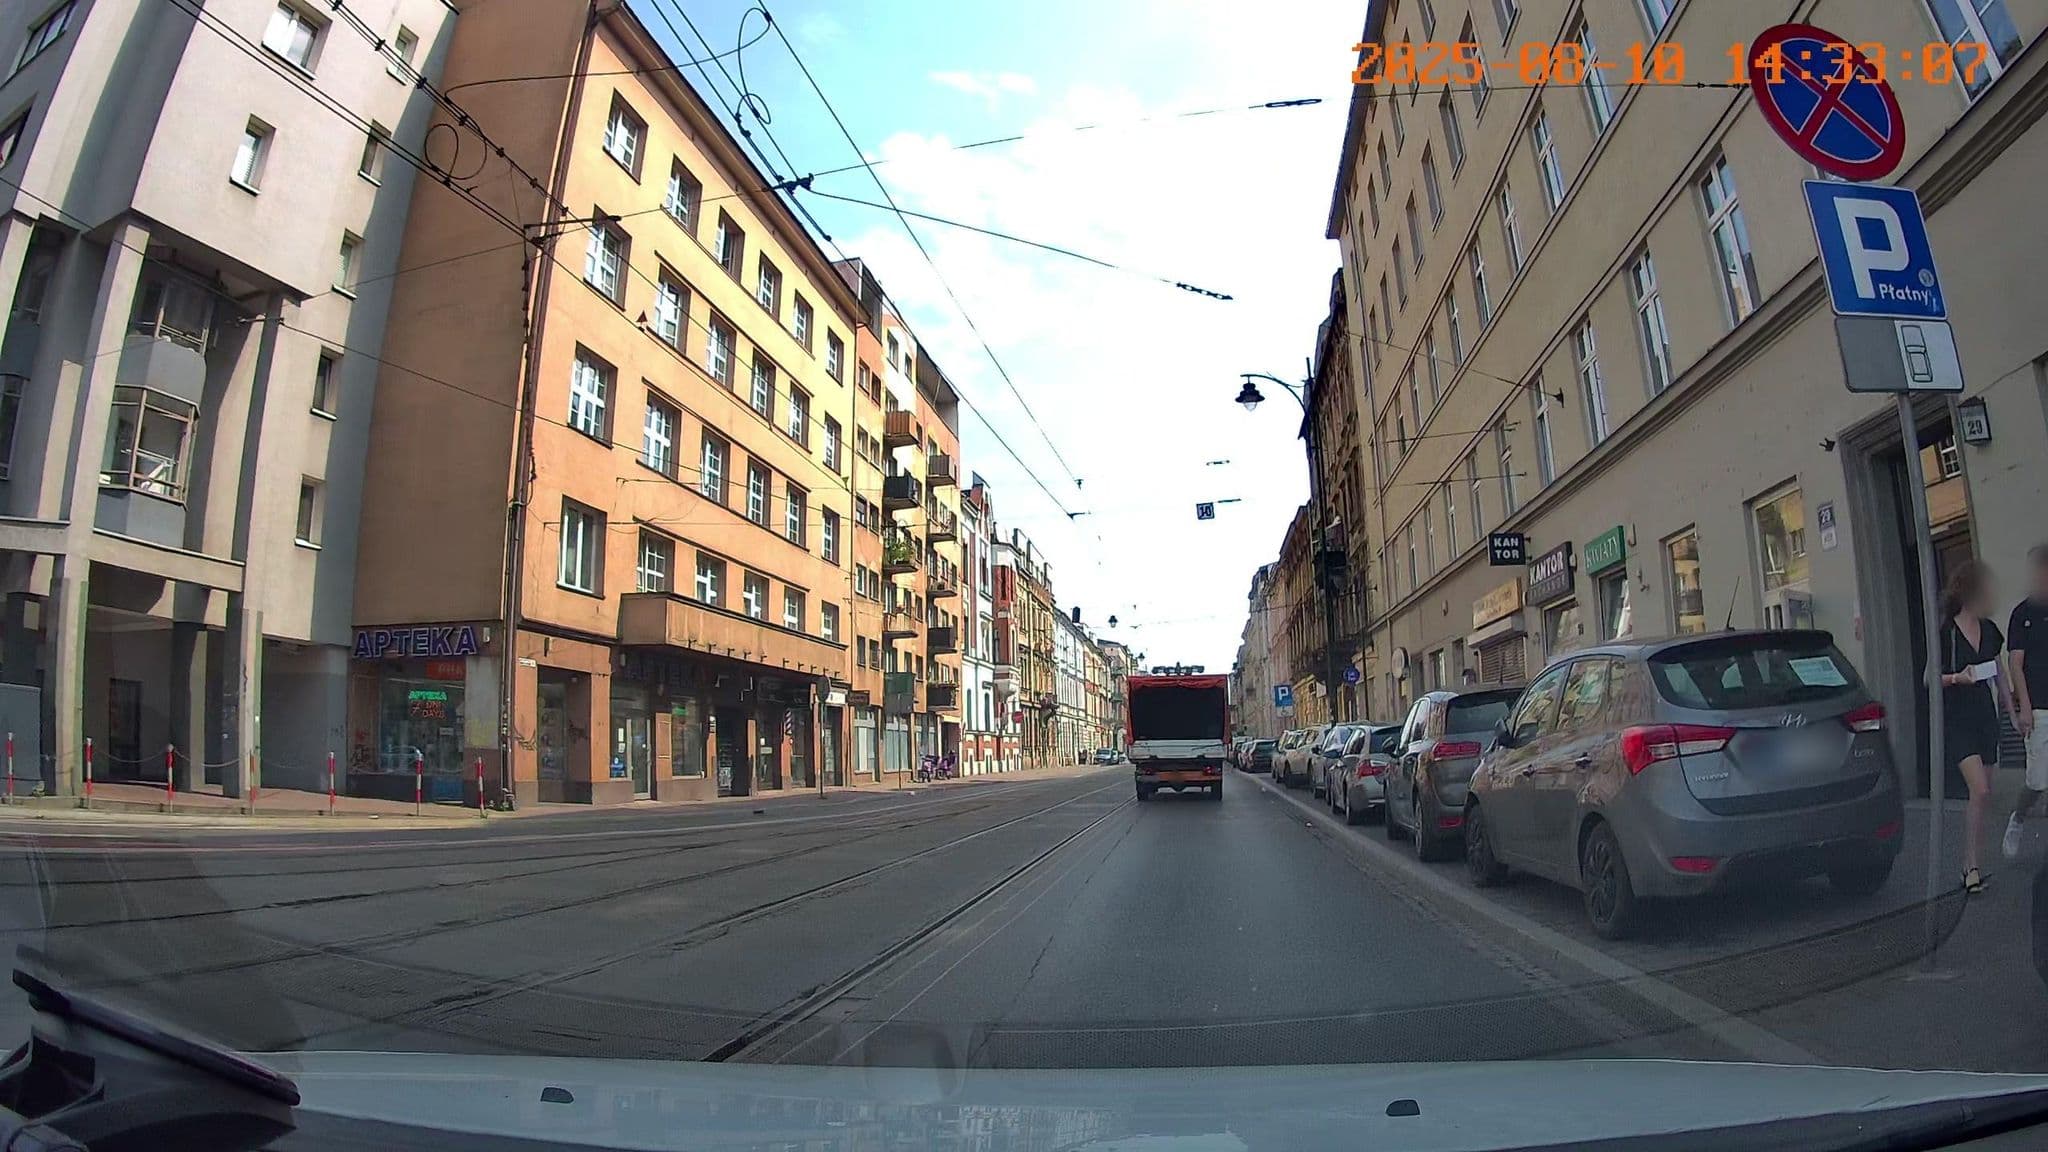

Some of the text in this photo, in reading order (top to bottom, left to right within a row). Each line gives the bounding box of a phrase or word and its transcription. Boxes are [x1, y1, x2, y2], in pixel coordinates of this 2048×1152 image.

[1833, 197, 1909, 299] P
[1879, 283, 1929, 306] Płatny
[1494, 538, 1519, 547] KAN
[1495, 550, 1520, 559] TOR
[1529, 551, 1564, 585] KANTOR
[352, 625, 477, 658] APTEKA
[1278, 687, 1288, 700] P
